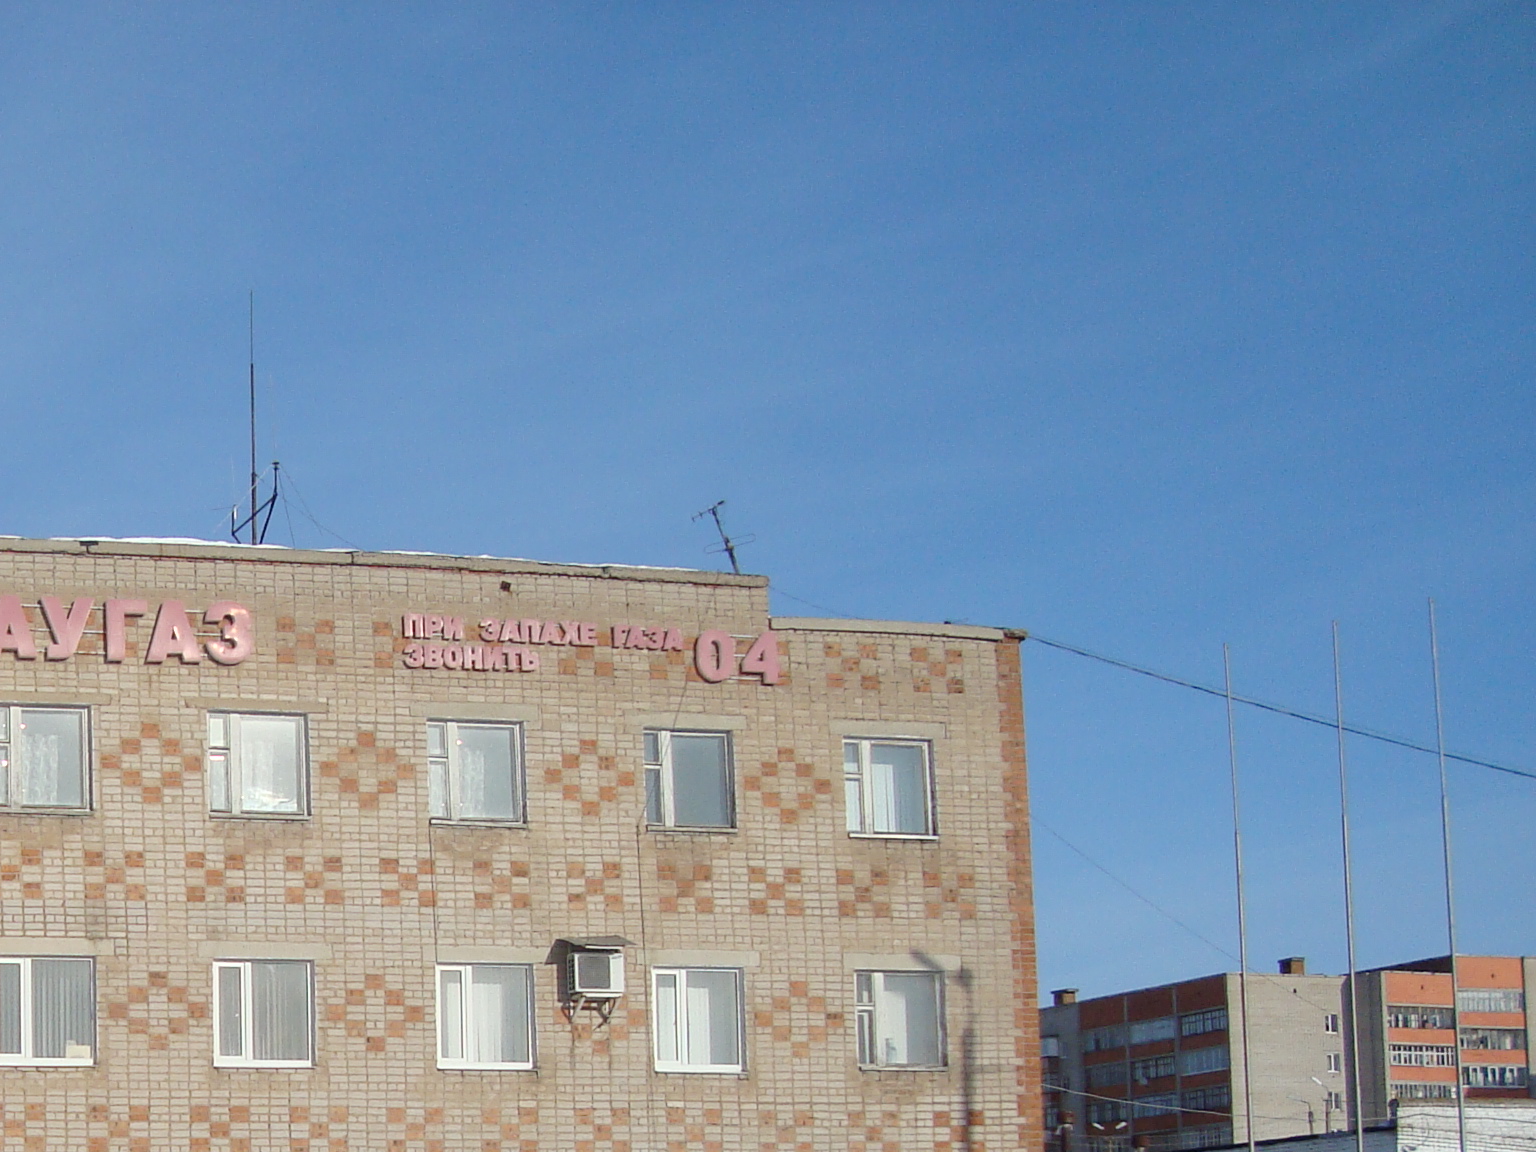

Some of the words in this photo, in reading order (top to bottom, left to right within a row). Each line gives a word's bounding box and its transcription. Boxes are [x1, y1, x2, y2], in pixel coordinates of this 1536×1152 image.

[402, 613, 463, 641] ПРИ
[478, 617, 598, 647] ЗАПАХЕ
[611, 625, 684, 651] ГАЗА
[402, 644, 541, 673] ЗВОНИТЬ
[694, 628, 782, 686] 04
